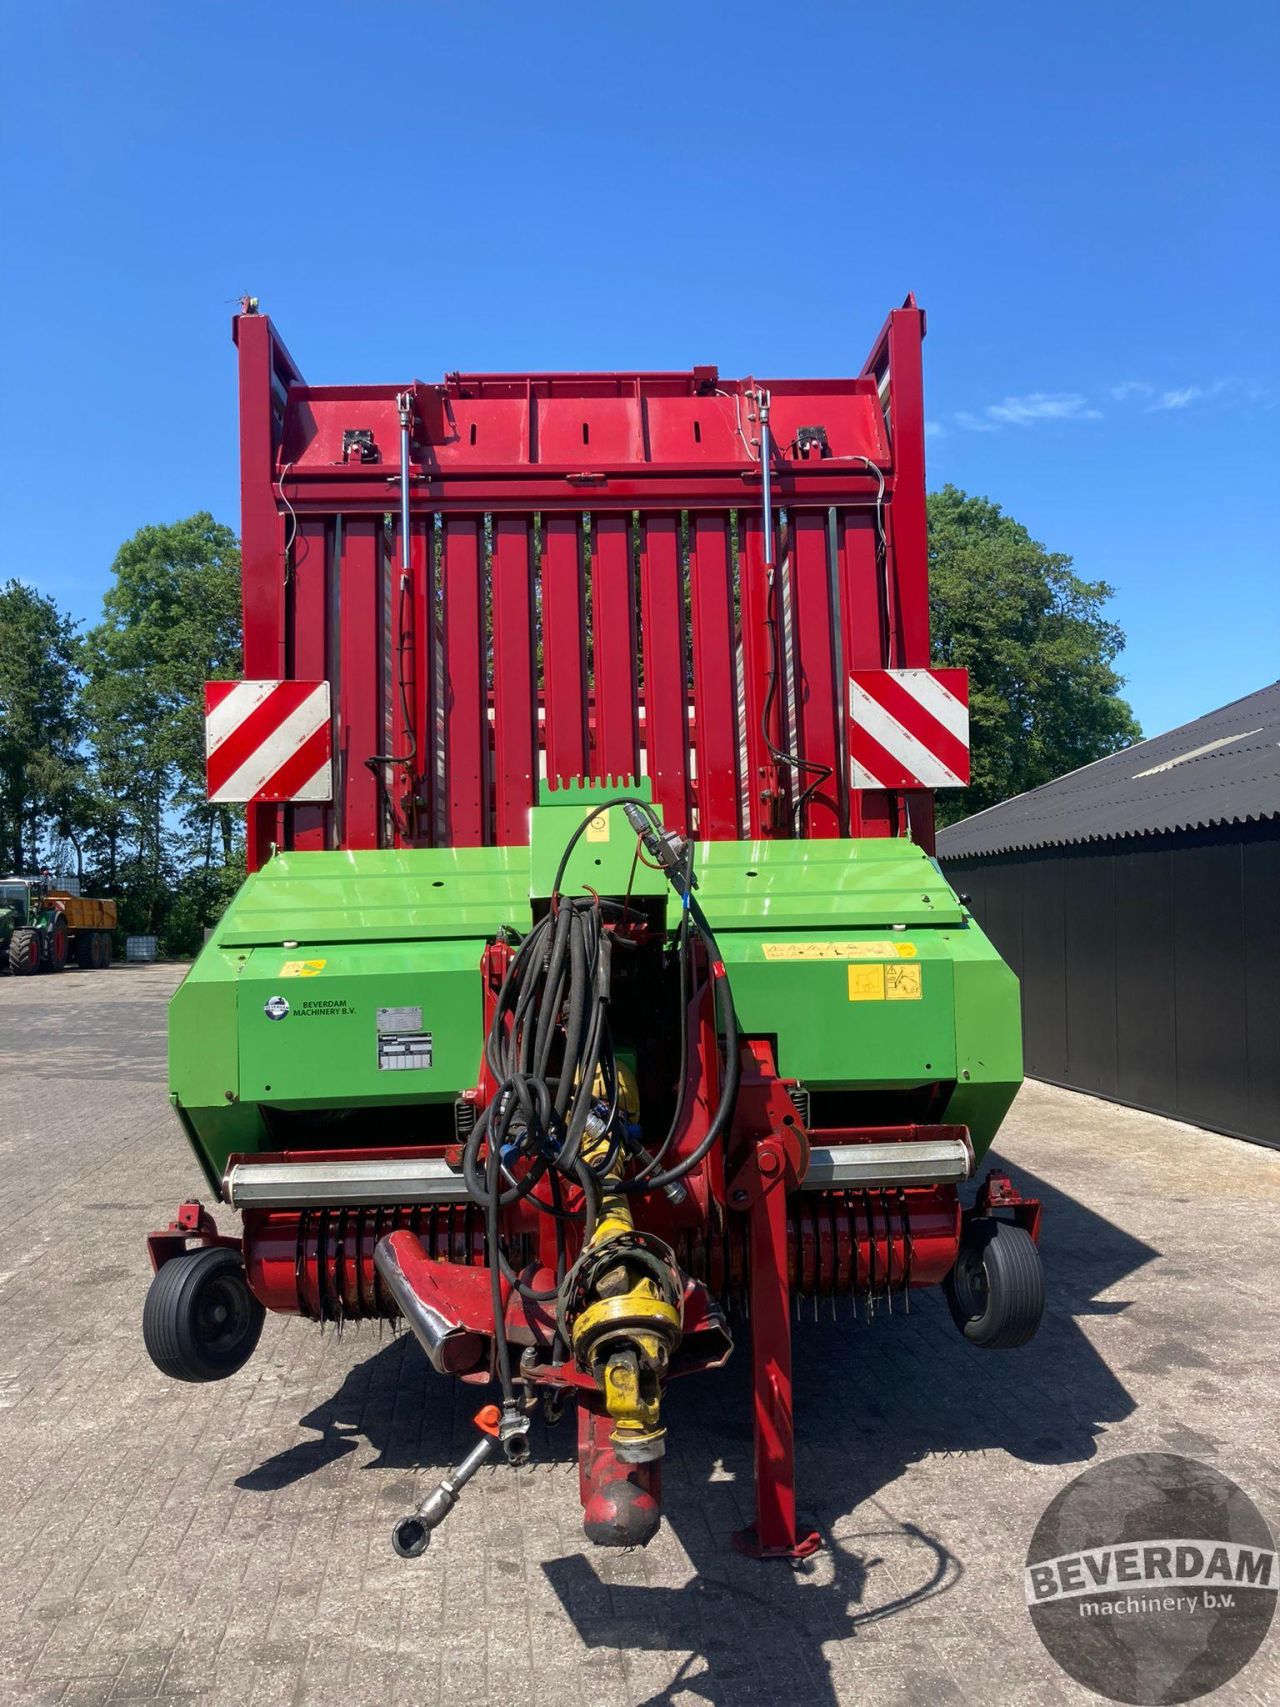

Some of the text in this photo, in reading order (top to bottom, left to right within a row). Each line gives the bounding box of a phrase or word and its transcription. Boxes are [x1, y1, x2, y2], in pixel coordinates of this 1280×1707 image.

[303, 1000, 347, 1008] BEVERDAM
[293, 1007, 357, 1016] MACHINERY B.V.
